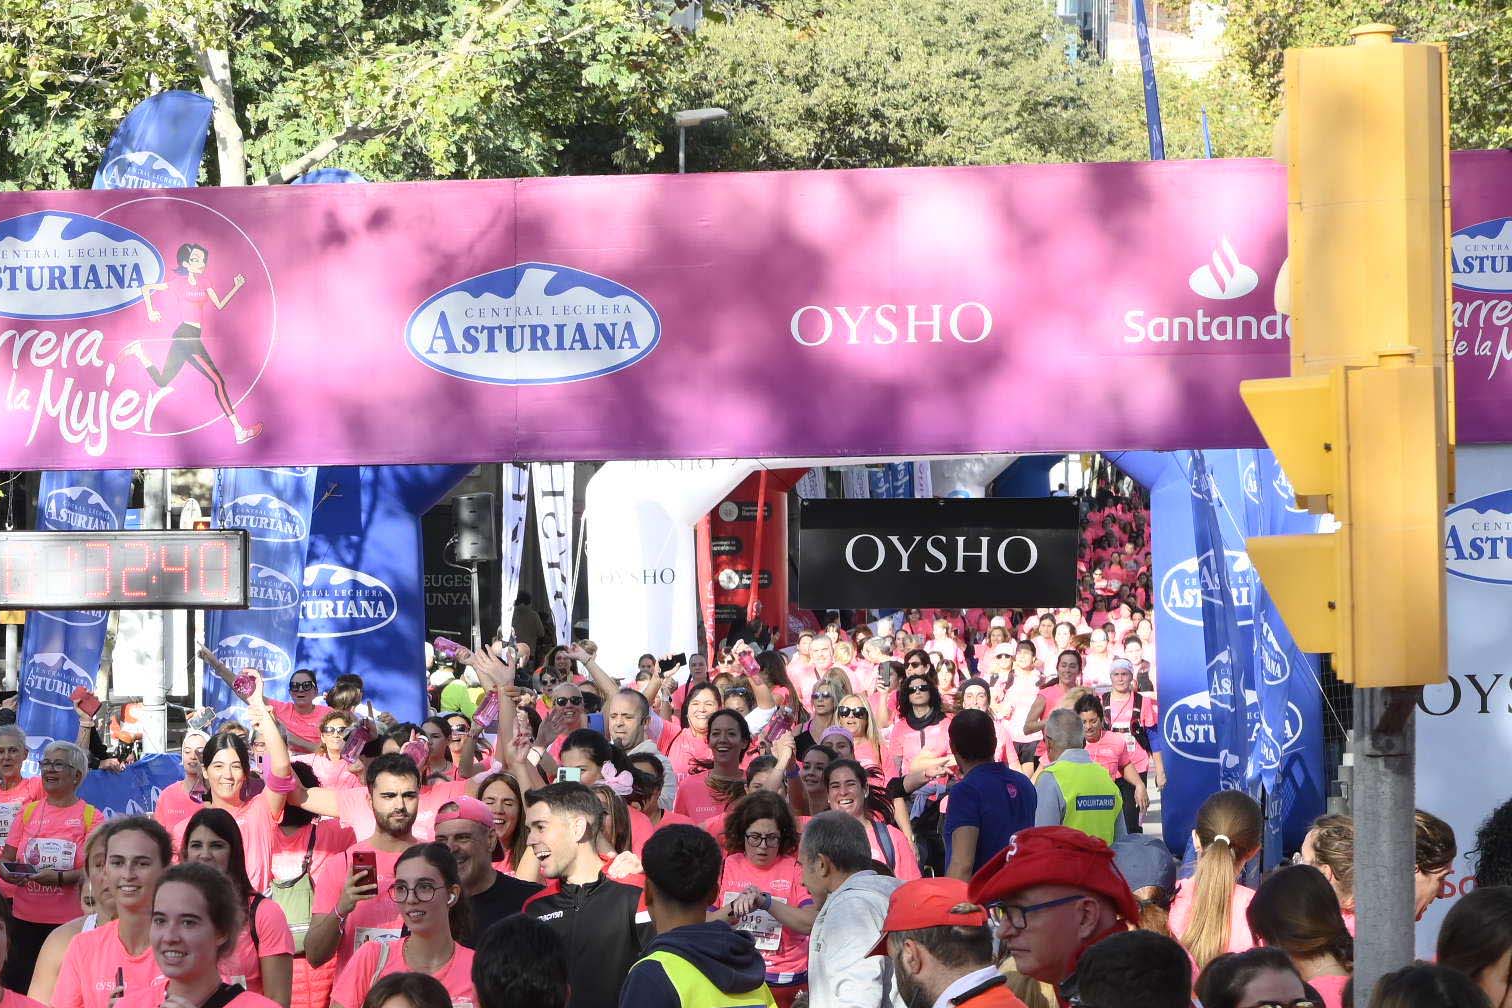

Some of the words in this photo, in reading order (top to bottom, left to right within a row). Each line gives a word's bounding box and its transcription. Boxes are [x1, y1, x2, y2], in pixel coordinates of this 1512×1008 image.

[68, 247, 140, 259] LECHERA
[1465, 243, 1511, 252] CENTRA
[465, 305, 544, 318] CENTRAL
[551, 304, 633, 316] LECHERA
[1451, 299, 1512, 328] arre
[425, 311, 641, 353] ASTURIANA
[790, 302, 993, 347] OYSHO
[1473, 332, 1492, 357] la
[6, 379, 31, 411] la
[26, 360, 174, 457] Mujer
[225, 510, 302, 537] ASTURIANA
[1472, 522, 1512, 532] CENT
[1445, 525, 1512, 560] ASTU
[845, 534, 1038, 575] OYSHO
[249, 586, 293, 604] RIANA
[302, 589, 331, 598] NTRAL
[333, 588, 384, 598] LECHERA
[1077, 797, 1115, 808] VOLUNTARIS
[41, 855, 58, 863] 016
[741, 914, 762, 923] 016
